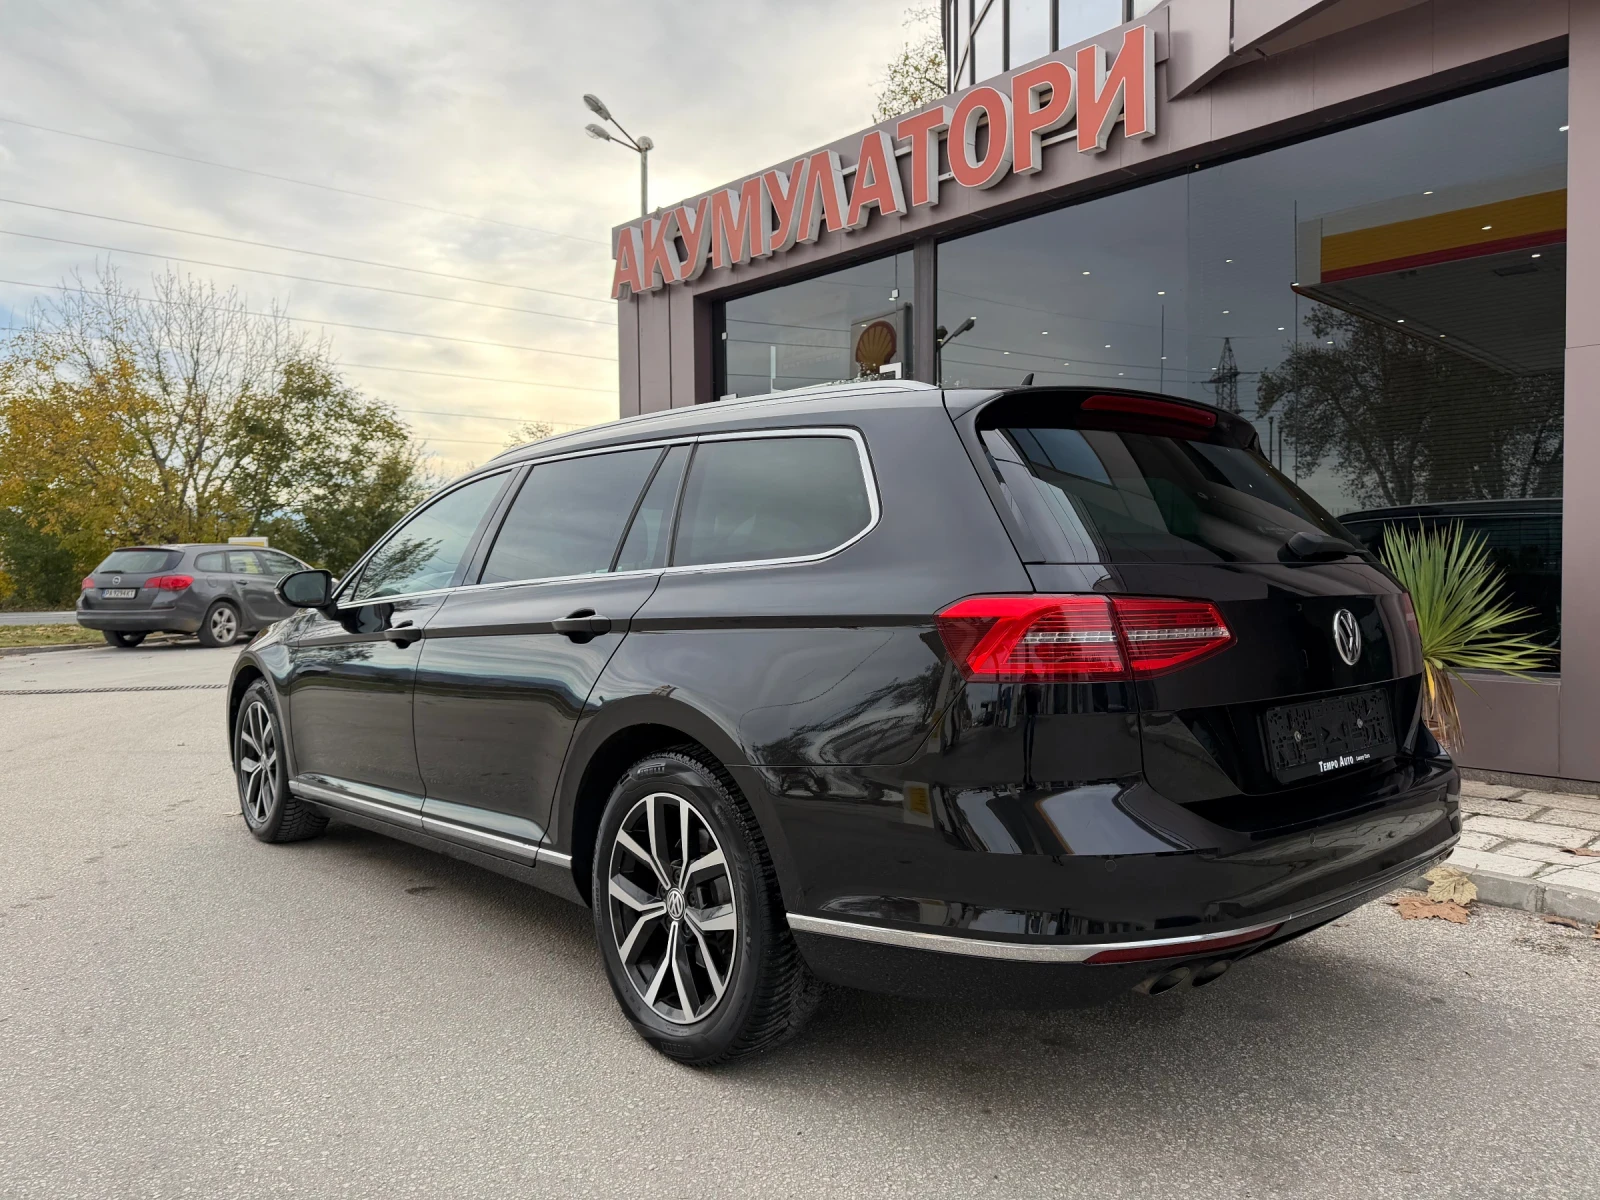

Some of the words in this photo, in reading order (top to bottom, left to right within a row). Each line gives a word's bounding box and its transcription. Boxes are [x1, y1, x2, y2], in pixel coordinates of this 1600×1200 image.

[611, 25, 1155, 299] АКУМУЛАТОРИ
[1318, 760, 1339, 772] TEMPO
[1340, 756, 1354, 767] AUTO
